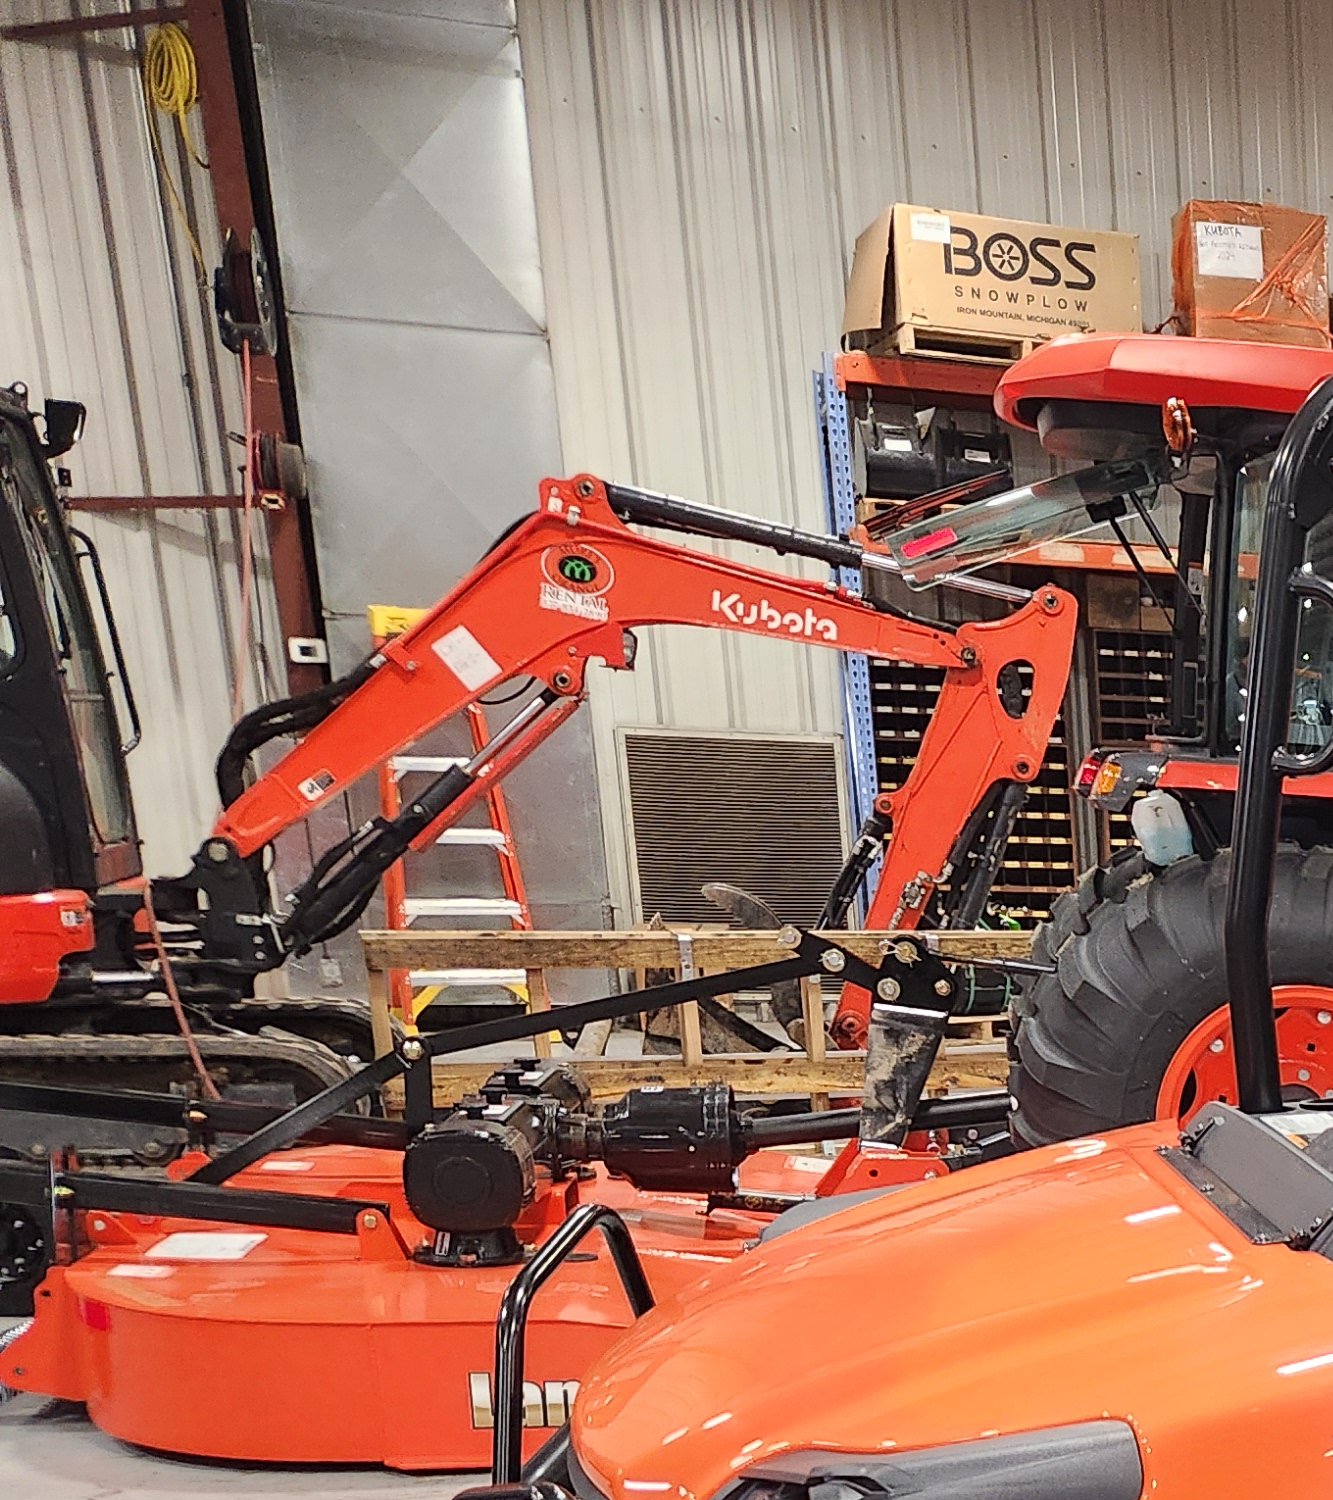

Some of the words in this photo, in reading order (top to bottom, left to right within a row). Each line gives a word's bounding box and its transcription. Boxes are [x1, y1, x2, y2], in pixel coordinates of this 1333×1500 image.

[1203, 224, 1242, 238] KUBOTA
[944, 226, 1096, 290] BOSS
[954, 285, 1088, 313] SNOWPLOW
[956, 306, 978, 316] IRON
[1026, 314, 1067, 326] MICHIGAN
[543, 585, 607, 612] RENTAL
[711, 589, 838, 641] Kubota
